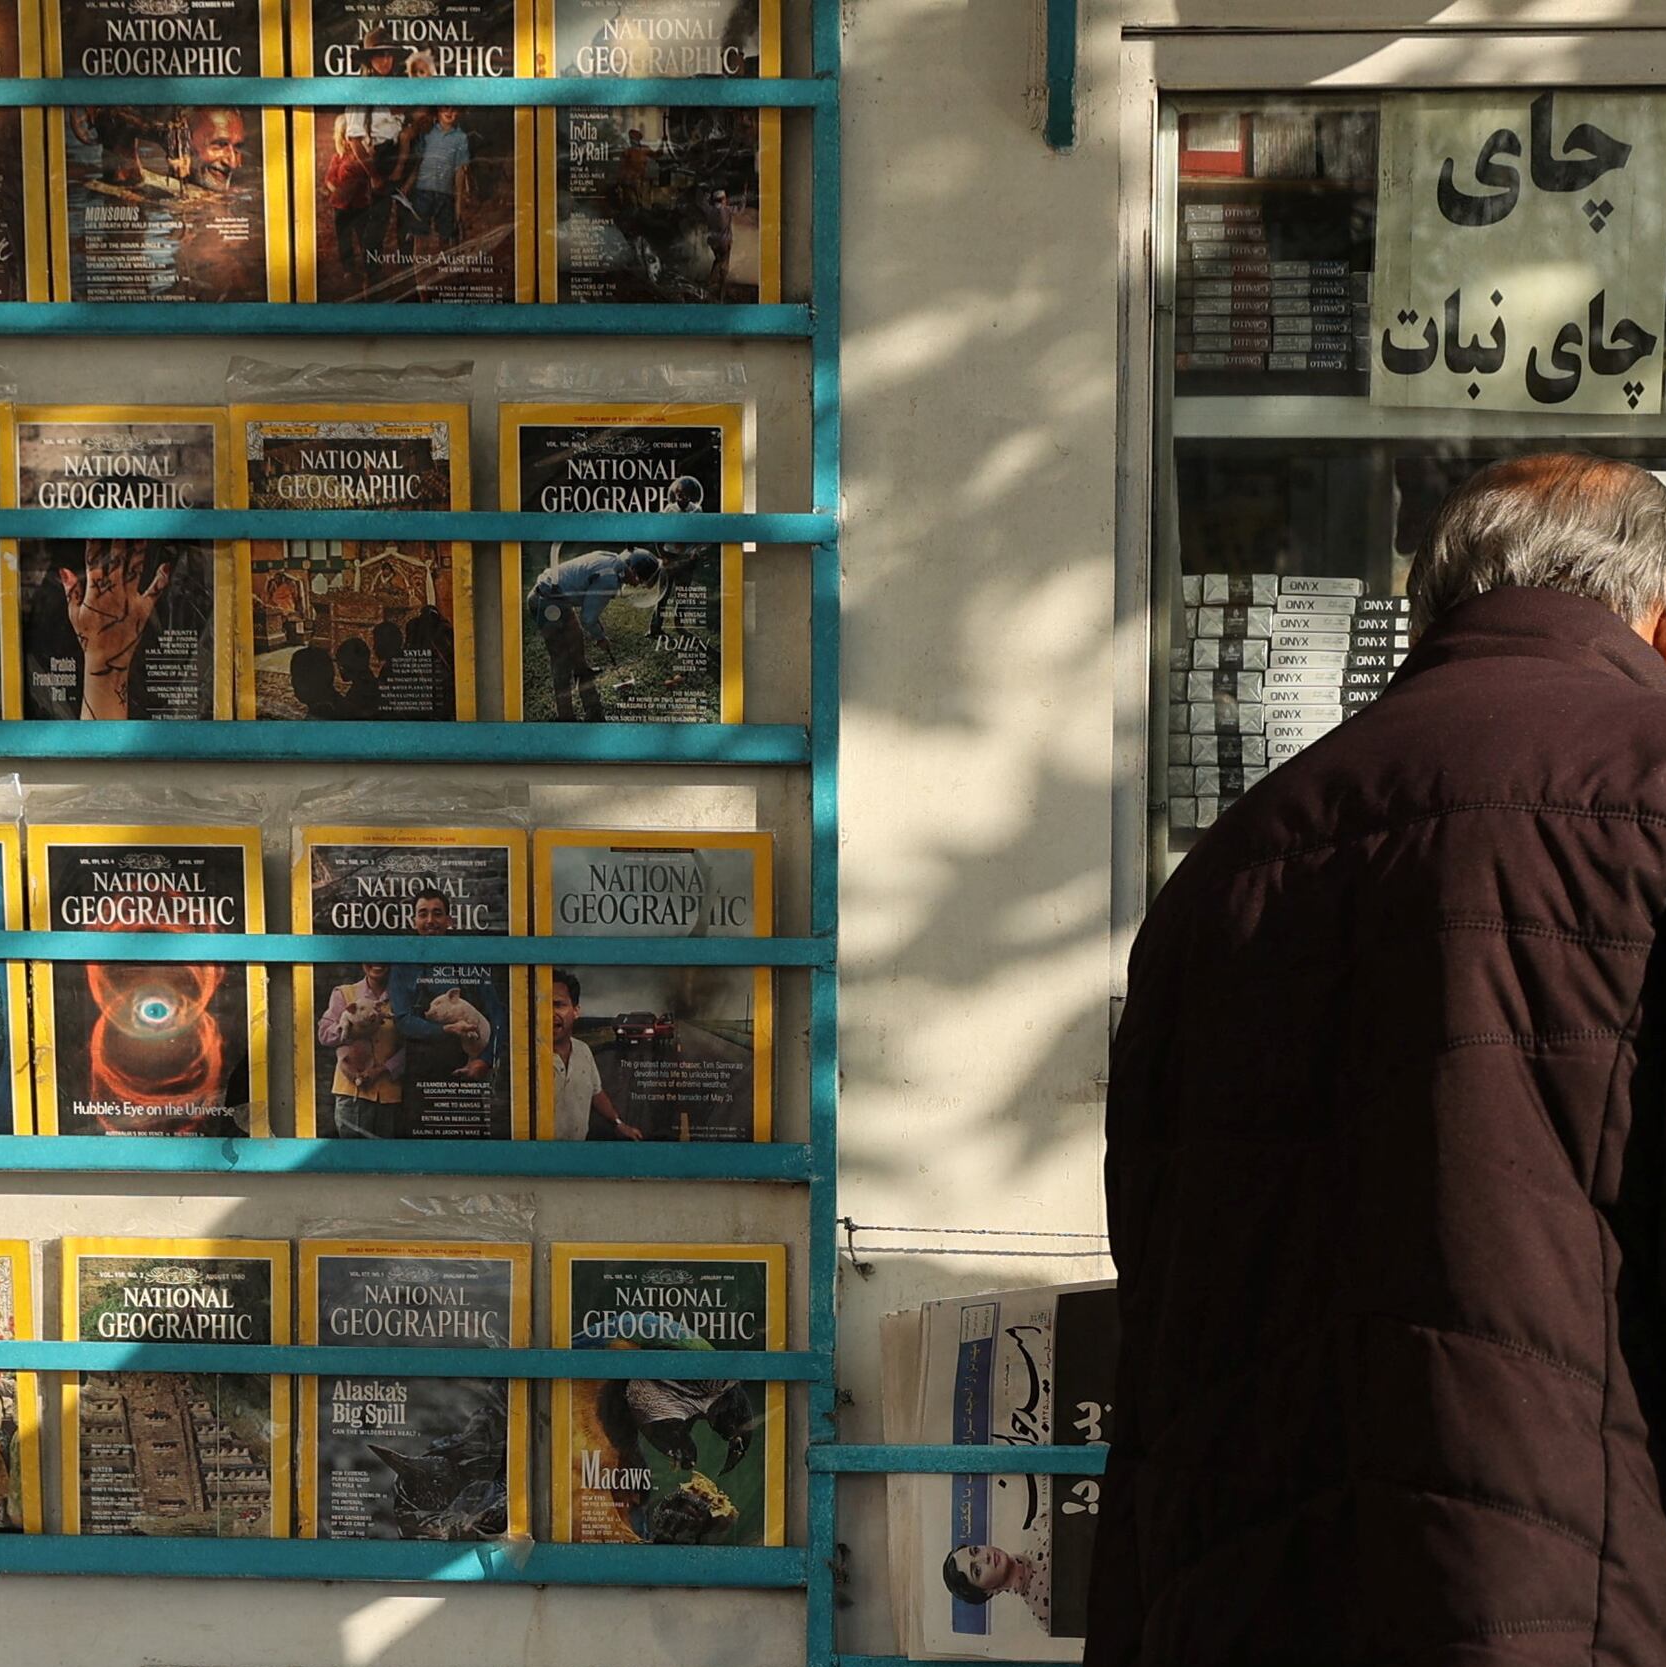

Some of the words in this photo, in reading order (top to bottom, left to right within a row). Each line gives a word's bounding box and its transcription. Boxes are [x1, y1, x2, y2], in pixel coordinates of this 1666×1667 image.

[107, 19, 221, 41] NATIONAL
[604, 19, 719, 40] NATIONAL
[82, 47, 242, 76] GEOGRAPHIC
[577, 47, 739, 74] GEOGRAPHIC
[570, 121, 597, 141] India
[570, 142, 585, 165] By
[586, 142, 609, 161] Rail
[1437, 92, 1633, 233] چای
[85, 207, 139, 221] MONSOONS
[366, 250, 433, 265] Northwest
[437, 251, 493, 265] Australia
[1381, 288, 1507, 400] نبات
[1525, 289, 1657, 410] چای
[64, 456, 176, 477] NATIONAL
[301, 450, 403, 469] NATIONAL
[567, 459, 679, 480] NATIONAL
[39, 482, 195, 509] GEOGRAPHIC
[278, 475, 421, 499] GEOGRAPHIC
[541, 486, 671, 513] GEOGRAPH
[1290, 581, 1318, 591] ONYX
[1286, 601, 1314, 610] ONYX
[1364, 601, 1393, 610] ONYX
[1281, 619, 1309, 628] ONYX
[1359, 619, 1388, 628] ONYX
[1280, 637, 1308, 646] ONYX
[1358, 637, 1387, 646] ONYX
[1279, 656, 1307, 665] ONYX
[1357, 656, 1386, 665] ONYX
[1273, 674, 1302, 682] ONYX
[1351, 674, 1380, 683] ONYX
[1271, 692, 1299, 700] ONYX
[1349, 692, 1378, 701] ONYX
[1273, 710, 1301, 719] ONYX
[1274, 728, 1303, 737] ONYX
[94, 872, 206, 892] NATIONAL
[589, 864, 703, 893] NATIONA
[61, 896, 235, 926] GEOGRAPHIC
[333, 902, 489, 930] GEOGRHIC
[433, 966, 491, 977] SICHUAN
[621, 1060, 631, 1068] The
[661, 1061, 677, 1069] storm
[634, 1070, 656, 1078] devoted
[670, 1070, 680, 1078] life
[689, 1070, 719, 1080] unlocking
[721, 1071, 730, 1079] the
[637, 1080, 666, 1088] mysteries
[668, 1080, 675, 1088] of
[631, 1092, 645, 1100] Then
[665, 1093, 676, 1101] the
[703, 1093, 709, 1101] of
[711, 1093, 723, 1103] May
[73, 1102, 121, 1116] Hubble's
[123, 1102, 144, 1118] Eye
[147, 1106, 162, 1116] on
[165, 1102, 183, 1116] the
[185, 1102, 235, 1118] Universe
[124, 1287, 234, 1308] NATIONAL
[365, 1285, 471, 1305] NATIONAL
[615, 1287, 727, 1308] NATIONAL
[98, 1313, 252, 1340] GEOGRAPHIC
[331, 1308, 498, 1338] GEOGRAPHIC
[583, 1310, 755, 1340] GEOGRAPHIC
[332, 1381, 408, 1401] Alaska's
[332, 1403, 363, 1427] Big
[365, 1404, 406, 1428] Spill
[581, 1450, 652, 1491] Macaws
